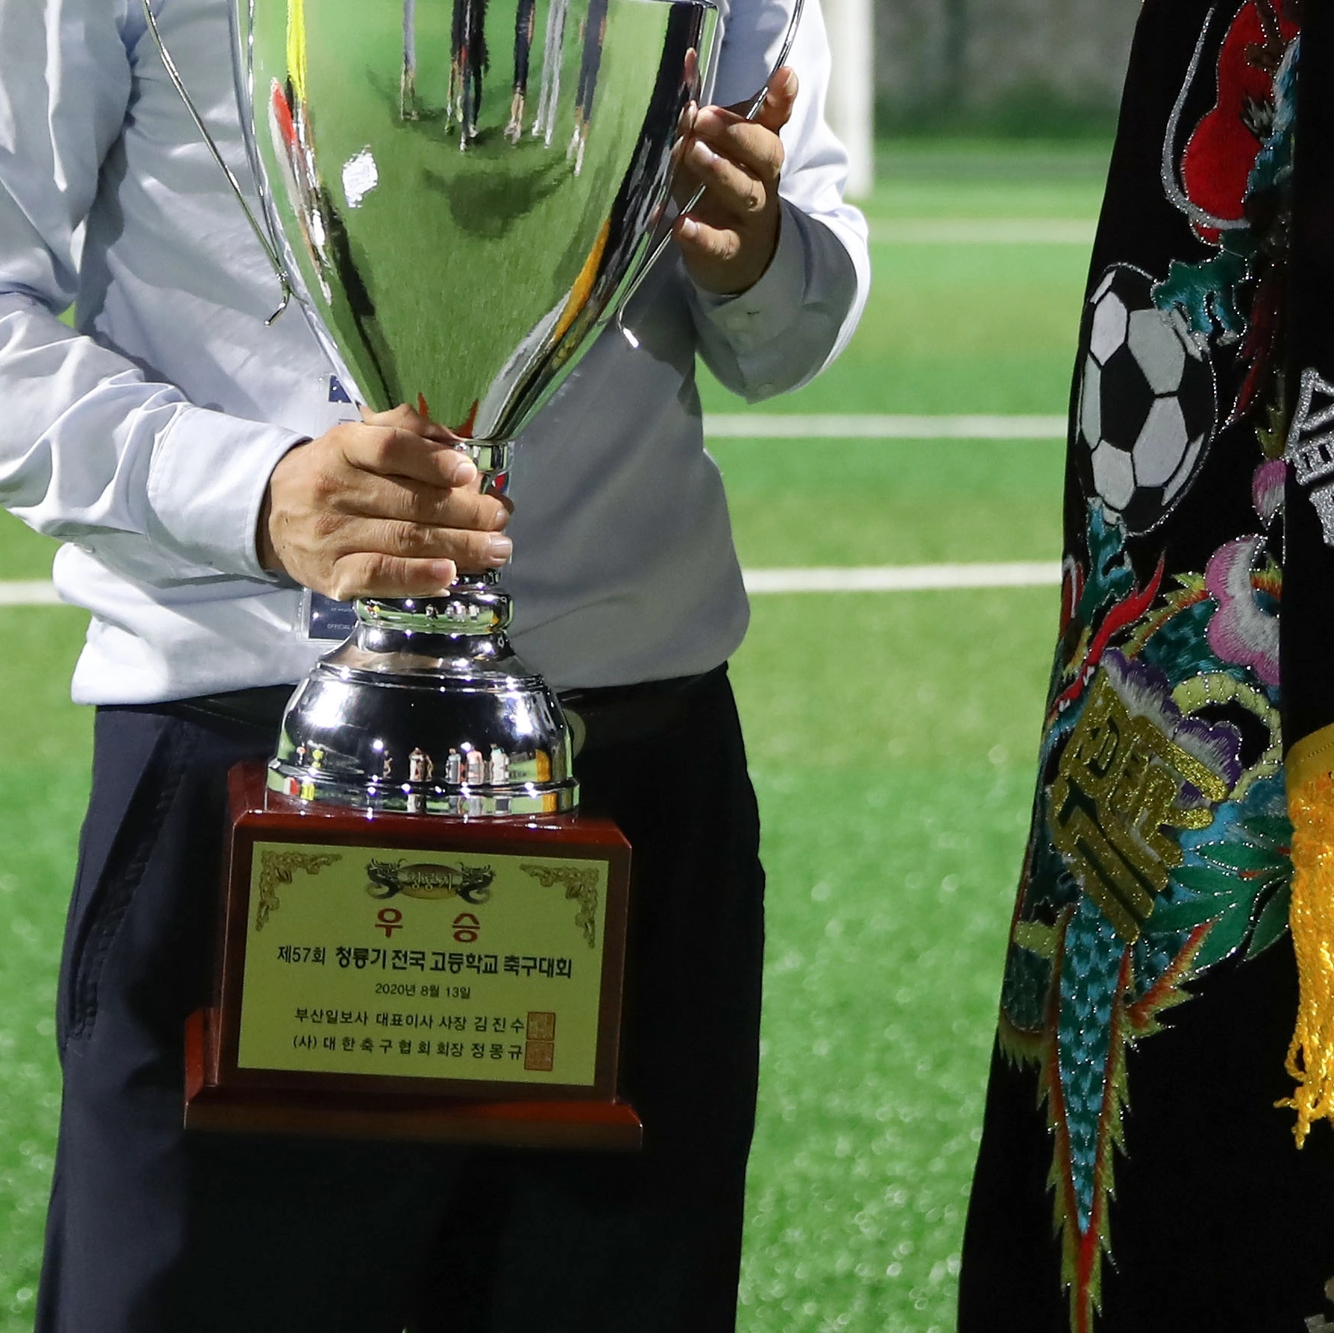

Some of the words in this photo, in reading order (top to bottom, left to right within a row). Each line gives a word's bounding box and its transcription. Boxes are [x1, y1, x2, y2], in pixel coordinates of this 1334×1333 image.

[277, 945, 326, 966] 제57회
[335, 945, 387, 970] 청룡기
[391, 949, 426, 972] 전국
[429, 951, 499, 975] 고등학교
[503, 954, 573, 980] 축구대회
[375, 982, 416, 997] 2020년
[420, 984, 440, 998] 8월
[446, 986, 471, 1000] 13일
[294, 1007, 369, 1026] 부산일보사
[375, 1012, 434, 1030] 대표이사
[438, 1015, 467, 1032] 사장
[293, 1034, 318, 1050] (사)
[436, 1041, 464, 1058] 회장
